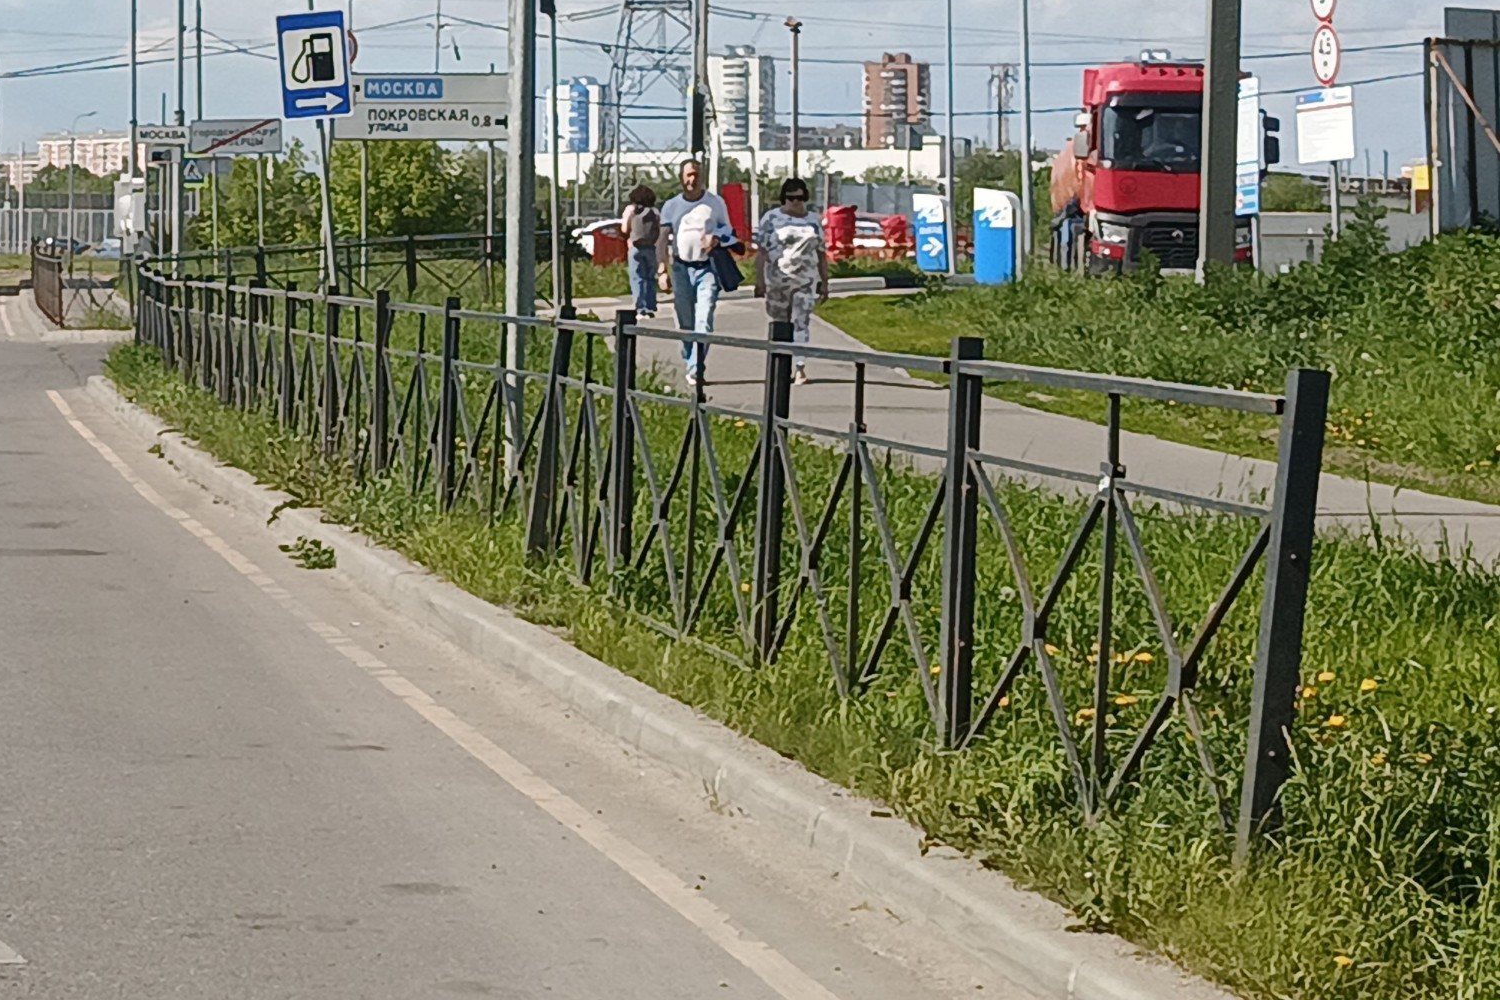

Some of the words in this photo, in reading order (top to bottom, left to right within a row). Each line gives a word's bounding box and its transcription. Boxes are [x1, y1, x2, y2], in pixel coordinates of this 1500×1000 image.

[367, 82, 438, 96] МОСКВА
[368, 108, 469, 122] ПОКРОВСКАЯ
[139, 130, 186, 139] МОСКВА
[367, 123, 408, 134] улица
